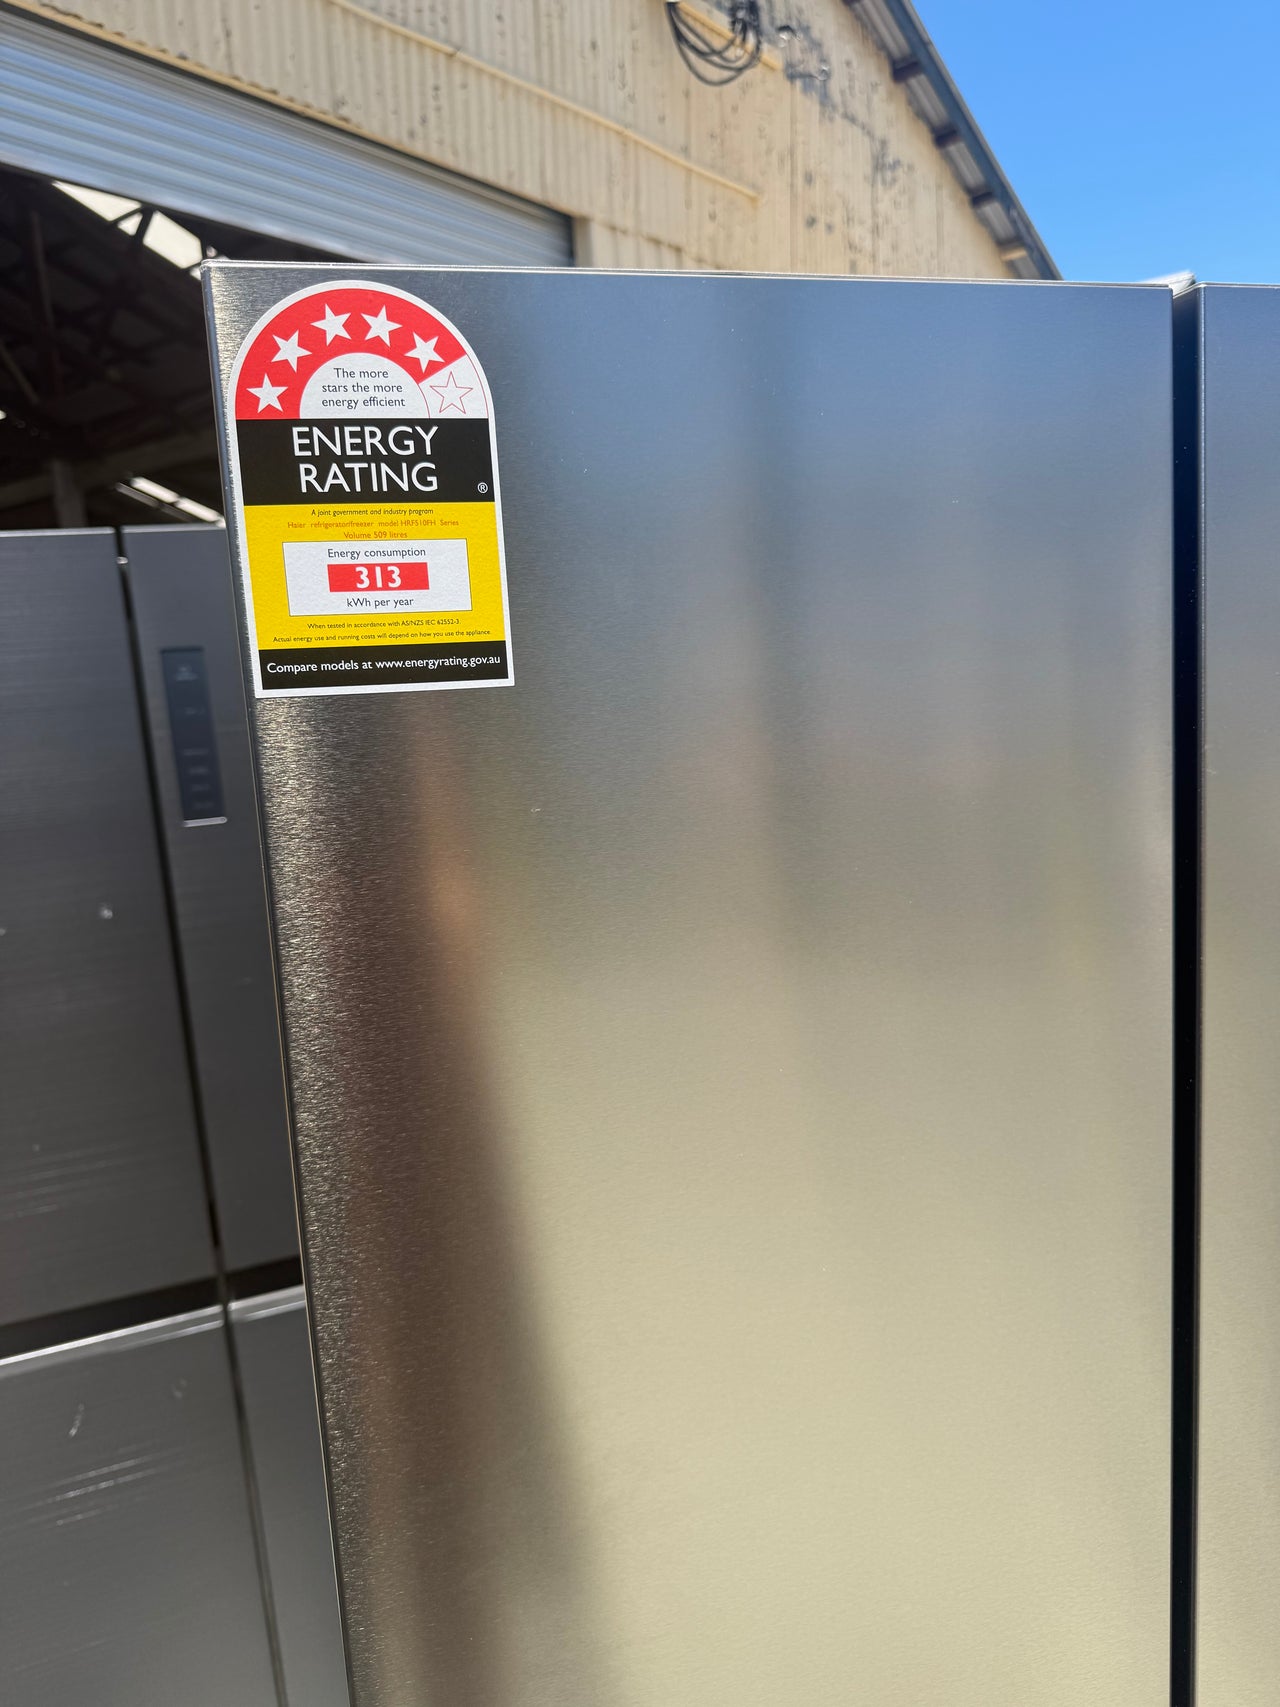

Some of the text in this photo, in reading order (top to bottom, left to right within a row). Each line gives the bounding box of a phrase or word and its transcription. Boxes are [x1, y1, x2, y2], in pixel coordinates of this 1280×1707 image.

[334, 367, 388, 378] The more
[322, 384, 348, 392] stars
[352, 382, 370, 392] the
[322, 396, 405, 410] energy efficient
[292, 426, 438, 456] ENERGY
[299, 462, 438, 493] RATING
[327, 548, 426, 560] Energy consumption
[355, 566, 402, 588] 313
[346, 598, 414, 609] kWh per year
[267, 662, 318, 675] Compare
[320, 660, 359, 670] models
[376, 656, 500, 670] www.energyrating.gov.au
